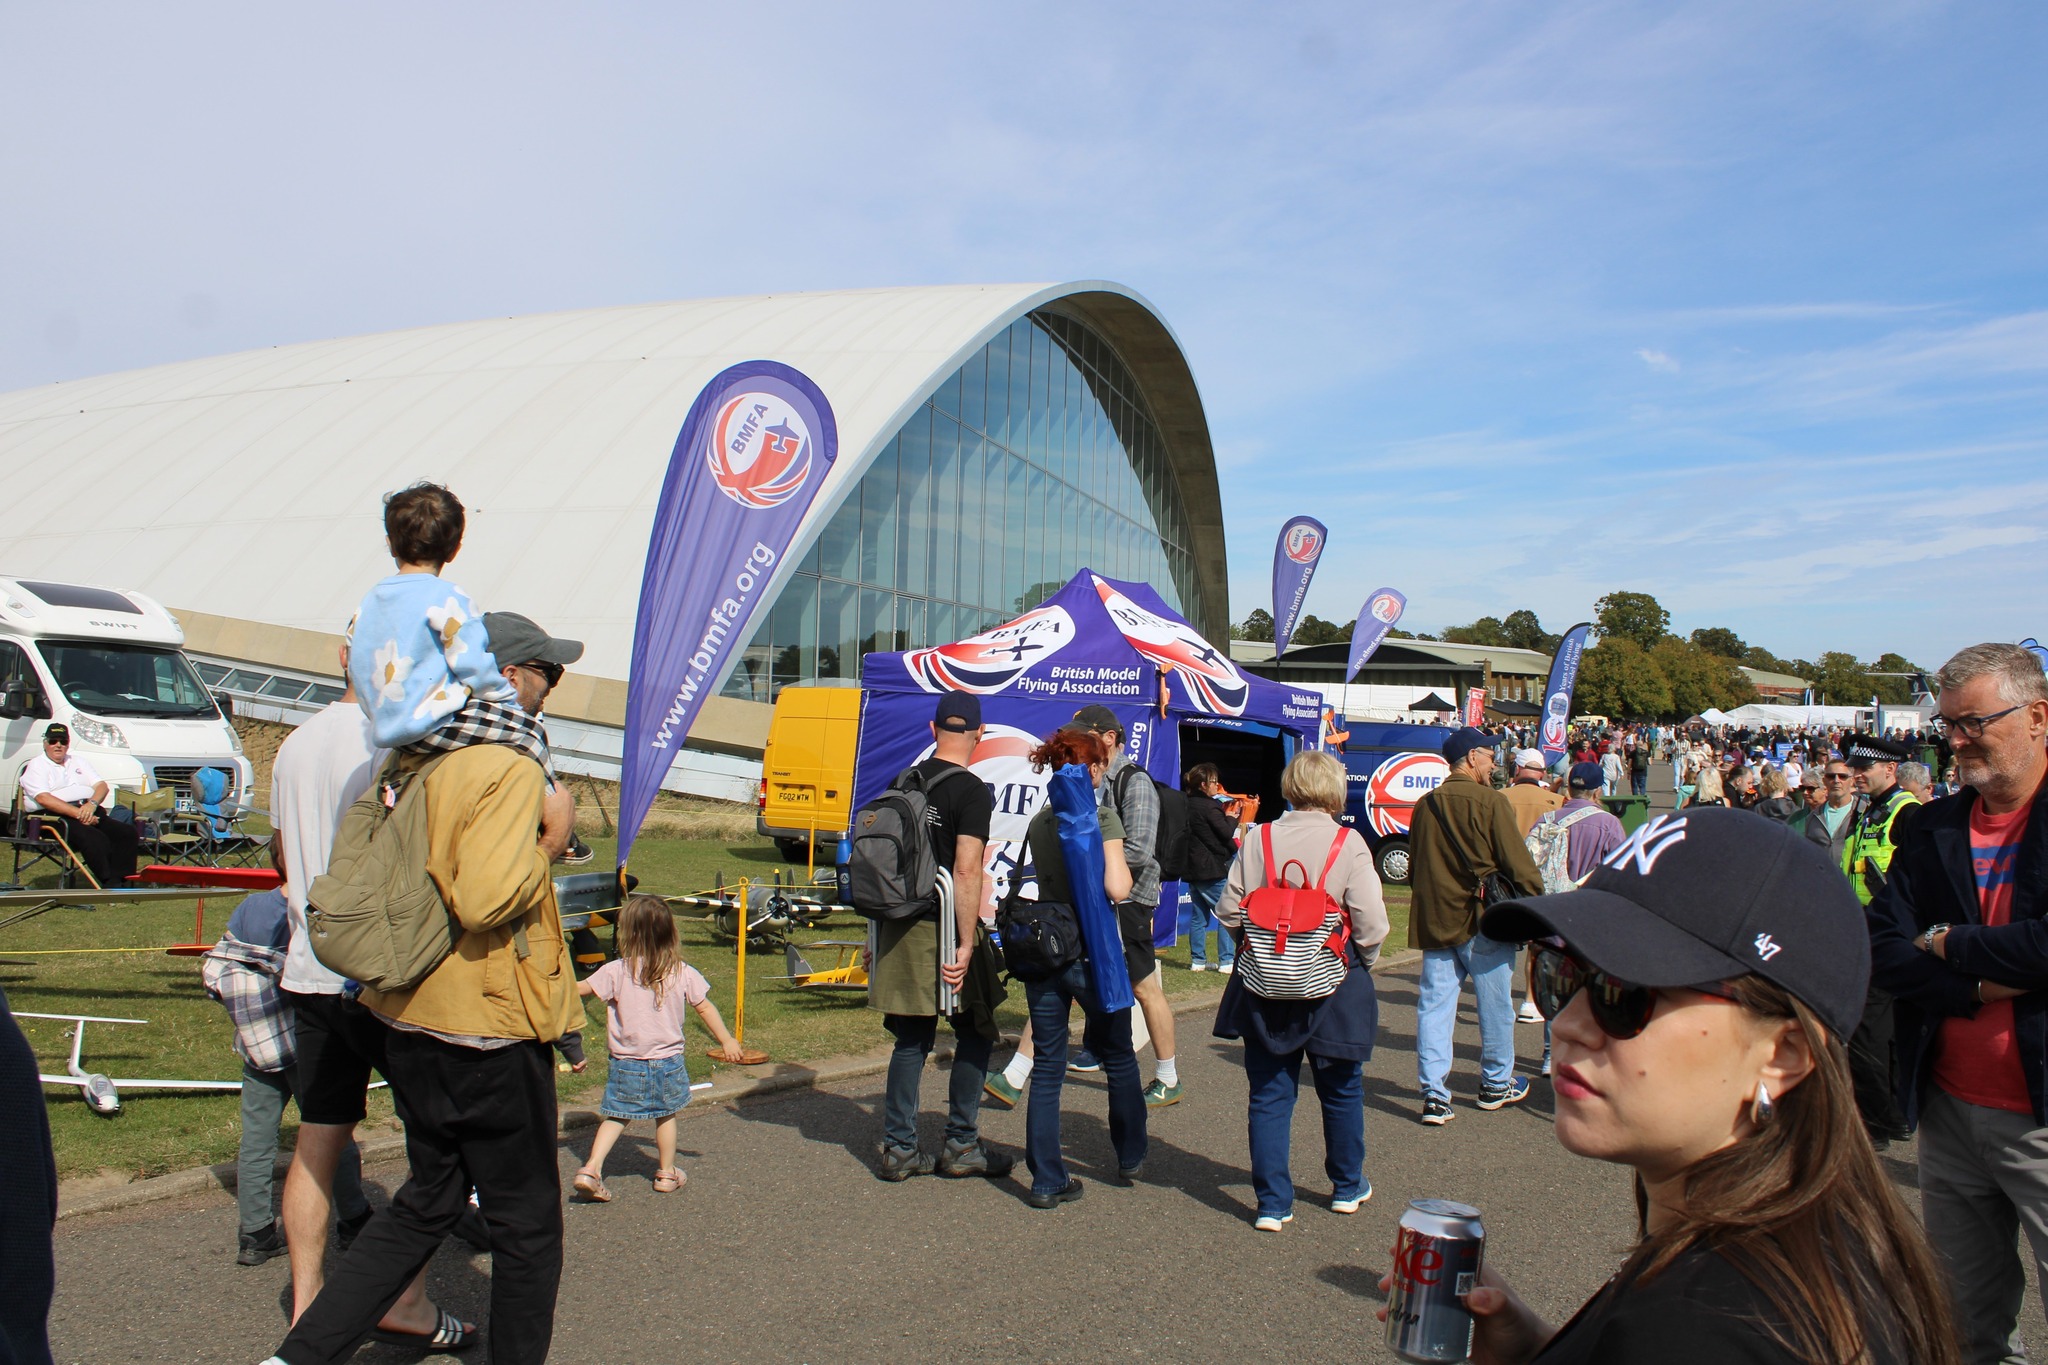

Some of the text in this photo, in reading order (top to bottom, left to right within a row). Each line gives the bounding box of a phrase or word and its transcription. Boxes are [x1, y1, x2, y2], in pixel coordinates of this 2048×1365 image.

[731, 404, 768, 455] BMFA
[1292, 528, 1303, 548] BMFA
[1282, 567, 1313, 637] www.bmfa.org
[89, 620, 138, 630] SWIFT
[991, 620, 1060, 639] BMFA
[652, 541, 776, 749] www.bmfa.org
[1051, 666, 1141, 681] British Model
[1017, 677, 1141, 695] Flying Association
[1291, 693, 1320, 707] British Model
[1282, 704, 1319, 719] Flying Association
[1128, 721, 1147, 764] s.org
[1403, 775, 1443, 789] BMF
[984, 781, 1051, 816] MF
[1341, 814, 1355, 823] org
[1394, 1226, 1444, 1286] ke
